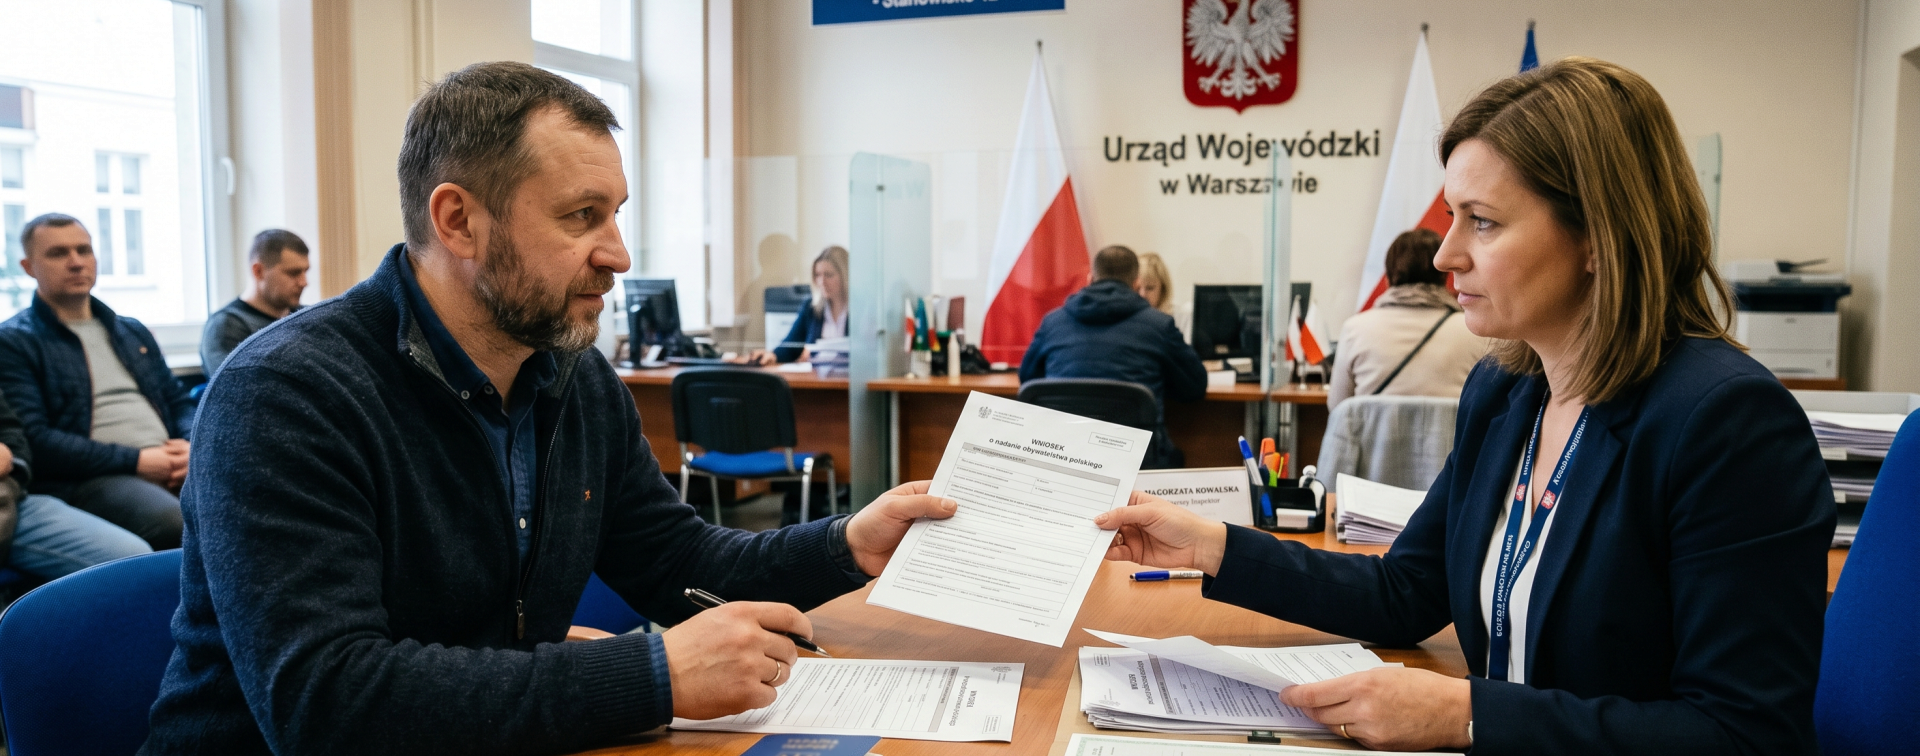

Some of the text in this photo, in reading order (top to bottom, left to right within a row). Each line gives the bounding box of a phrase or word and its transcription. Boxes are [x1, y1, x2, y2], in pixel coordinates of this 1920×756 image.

[1104, 134, 1186, 167] Urząd
[1160, 179, 1180, 195] w
[1031, 438, 1065, 452] WNIOSEK
[995, 439, 1021, 450] nadanie
[1022, 445, 1068, 462] obywatelstwa
[1068, 456, 1103, 470] polskiego
[1195, 486, 1240, 494] KOWALSKA
